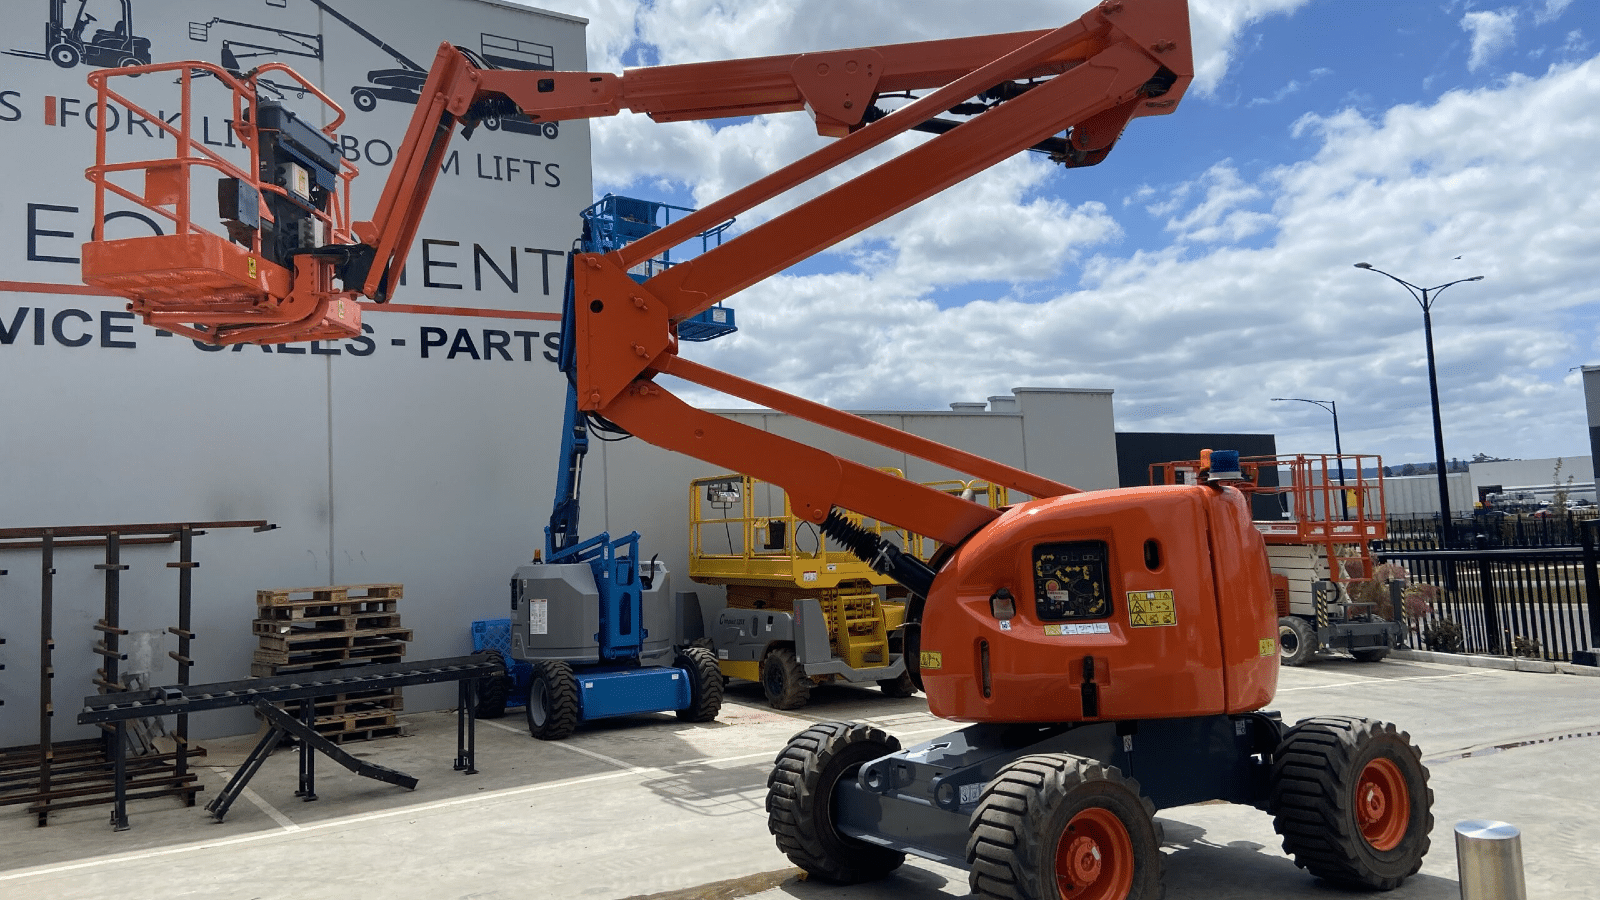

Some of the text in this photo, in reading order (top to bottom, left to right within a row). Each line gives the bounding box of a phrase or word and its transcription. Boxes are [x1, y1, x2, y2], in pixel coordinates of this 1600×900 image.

[60, 97, 182, 139] FORK
[340, 134, 561, 187] BOM LIFTS
[420, 326, 562, 363] PARTS
